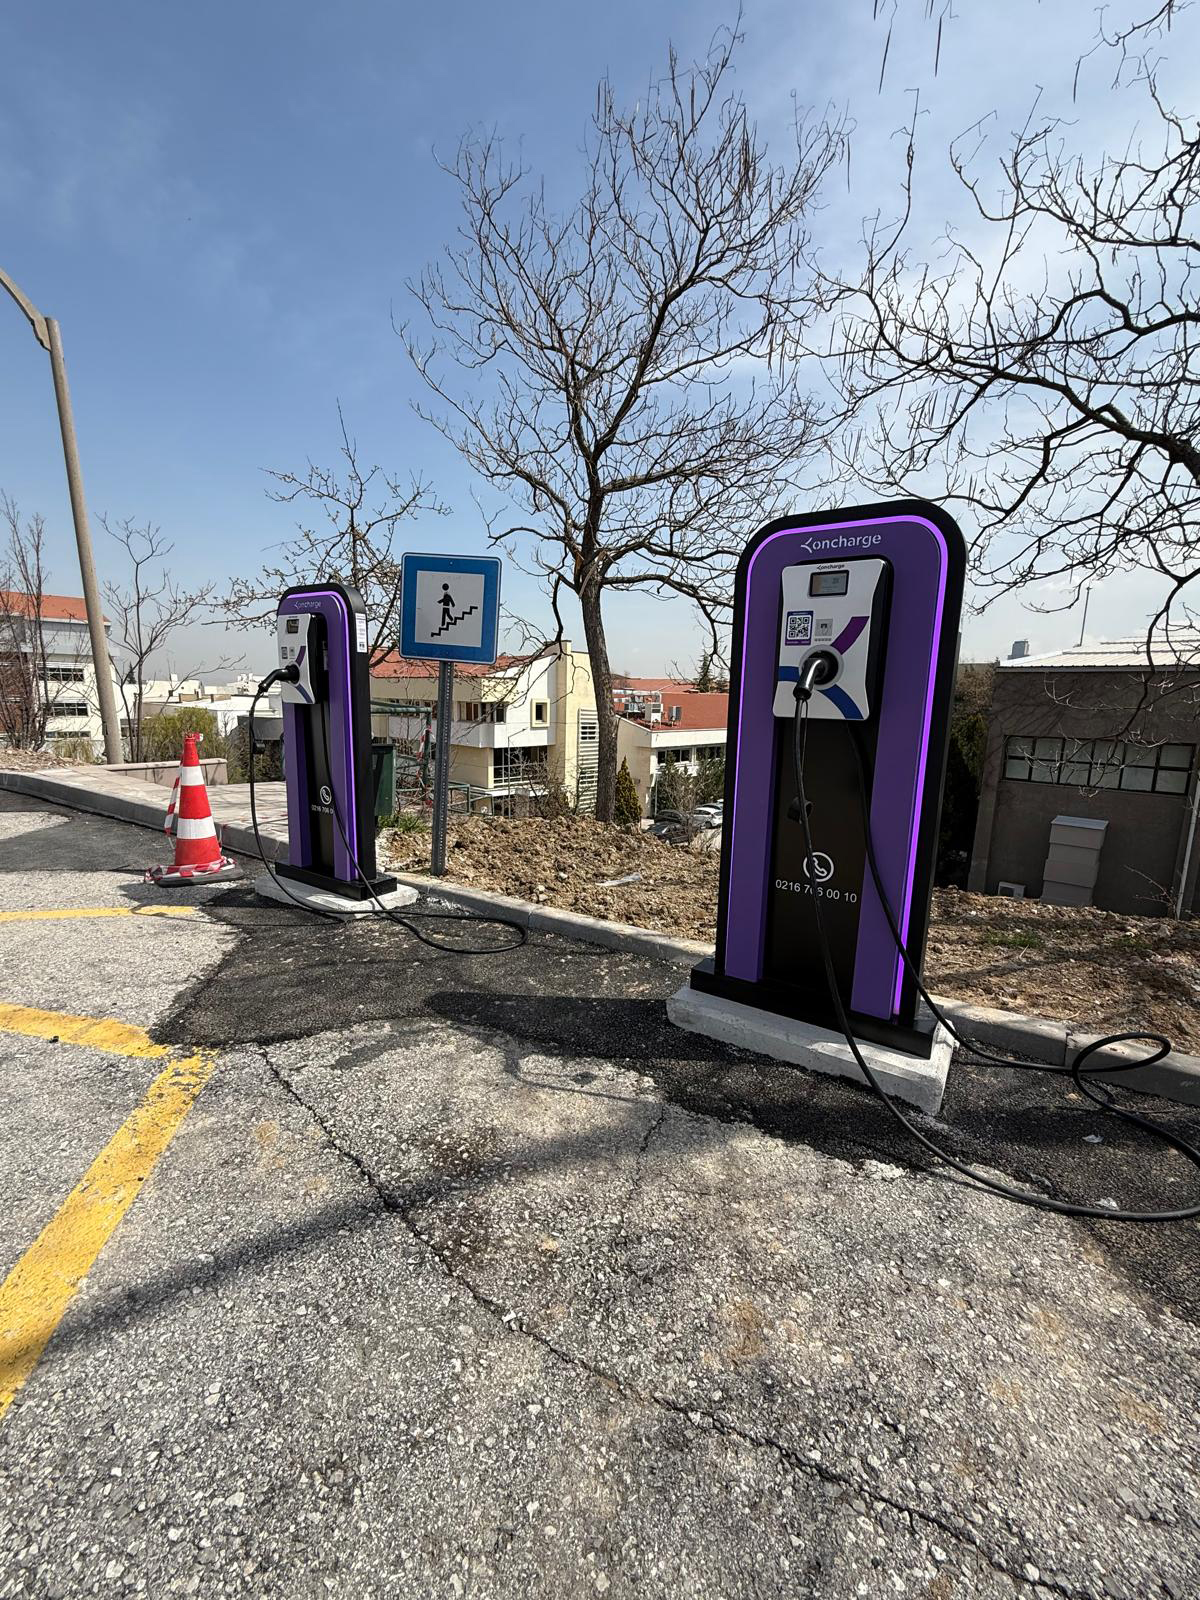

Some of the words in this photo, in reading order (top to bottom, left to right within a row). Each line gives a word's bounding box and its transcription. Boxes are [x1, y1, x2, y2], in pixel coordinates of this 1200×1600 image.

[812, 534, 882, 550] oncharge
[820, 563, 845, 571] oncharge
[775, 879, 801, 893] 0216
[826, 888, 840, 900] 00
[844, 892, 857, 903] 10
